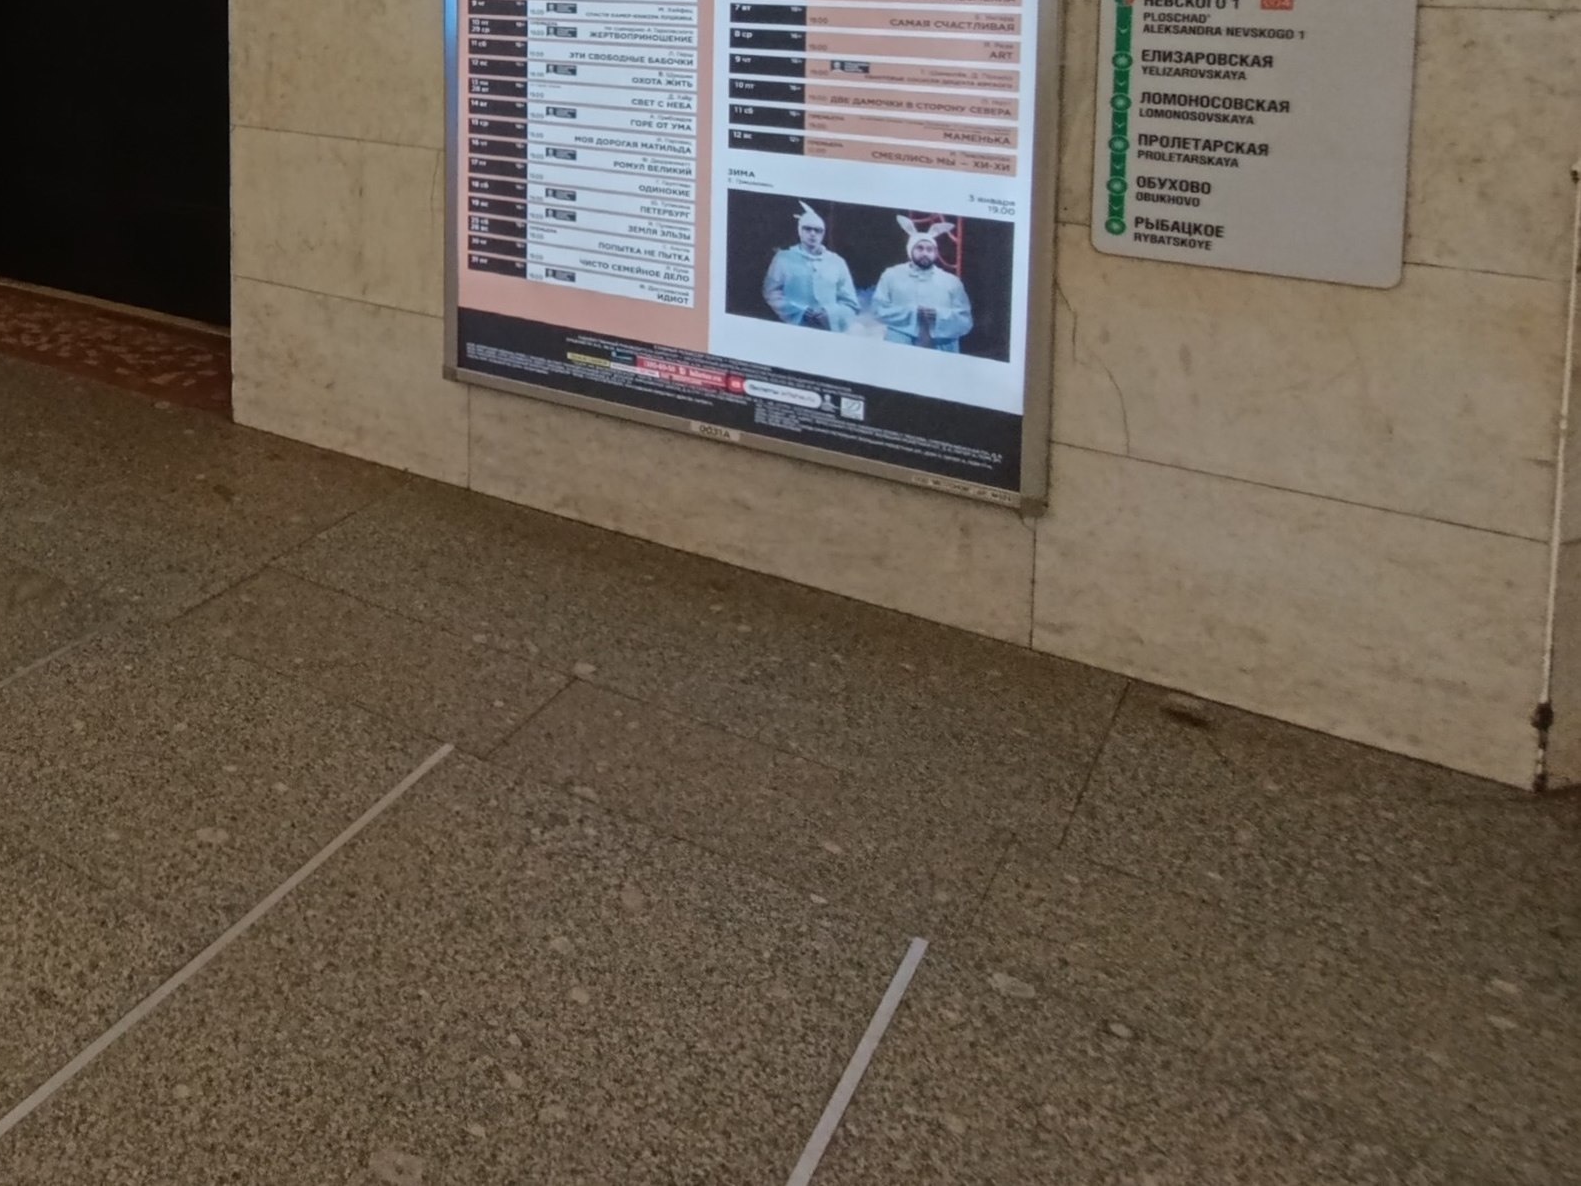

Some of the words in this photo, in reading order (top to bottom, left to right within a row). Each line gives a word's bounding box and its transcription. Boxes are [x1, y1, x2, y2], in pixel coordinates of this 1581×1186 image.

[889, 18, 930, 27] САМАЯ
[933, 19, 1015, 31] СЧАСТЛИВАЯ
[1143, 24, 1222, 36] ALEKSANDRA
[1226, 27, 1294, 40] NEVSKOGO
[589, 31, 693, 43] ЖЕРТВОПРИНОШЕНИЕ
[588, 53, 645, 63] СВОБОДНЫЕ
[648, 56, 694, 66] БАБОЧКИ
[1141, 49, 1274, 68] ЕЛИЗАРОВСКАЯ
[1141, 65, 1247, 80] YELIZAROVSKAYA
[631, 77, 662, 85] ОХОТА
[665, 79, 693, 88] ЖИТЬ
[631, 98, 655, 107] СВЕТ
[666, 101, 692, 110] НЕБА
[1140, 91, 1290, 113] ЛОМОНОСОВСКАЯ
[1139, 107, 1255, 125] LOMONOSOVSKAYA
[630, 119, 653, 128] ГОРЕ
[656, 121, 668, 129] ОТ
[670, 122, 692, 131] УМА
[1138, 133, 1269, 156] ПРОЛЕТАРСКАЯ
[1137, 149, 1239, 168] PROLETARSKAYA
[613, 160, 645, 170] РОМУЛ
[647, 164, 692, 176] ВЕЛИКИЙ
[638, 184, 691, 197] ОДИНОКИЕ
[1136, 175, 1212, 195] ОБУХОВО
[1136, 191, 1200, 207] OBUKHOVO
[640, 205, 690, 219] ПЕТЕРБУРГ
[627, 224, 658, 235] ЗЕМЛЯ
[660, 228, 691, 240] ЭЛЬЗЫ
[1134, 216, 1225, 238] РЫБАЦКОЕ
[1133, 231, 1213, 251] RYBATSKOYE
[598, 241, 642, 254] ПОПЫТКА
[643, 249, 656, 257] НЕ
[658, 250, 690, 262] ПЫТКА
[579, 258, 609, 269] ЧИСТО
[611, 263, 661, 278] СЕМЕЙНОЕ
[663, 272, 690, 283] ДЕЛО
[657, 293, 688, 304] ИДИОТ
